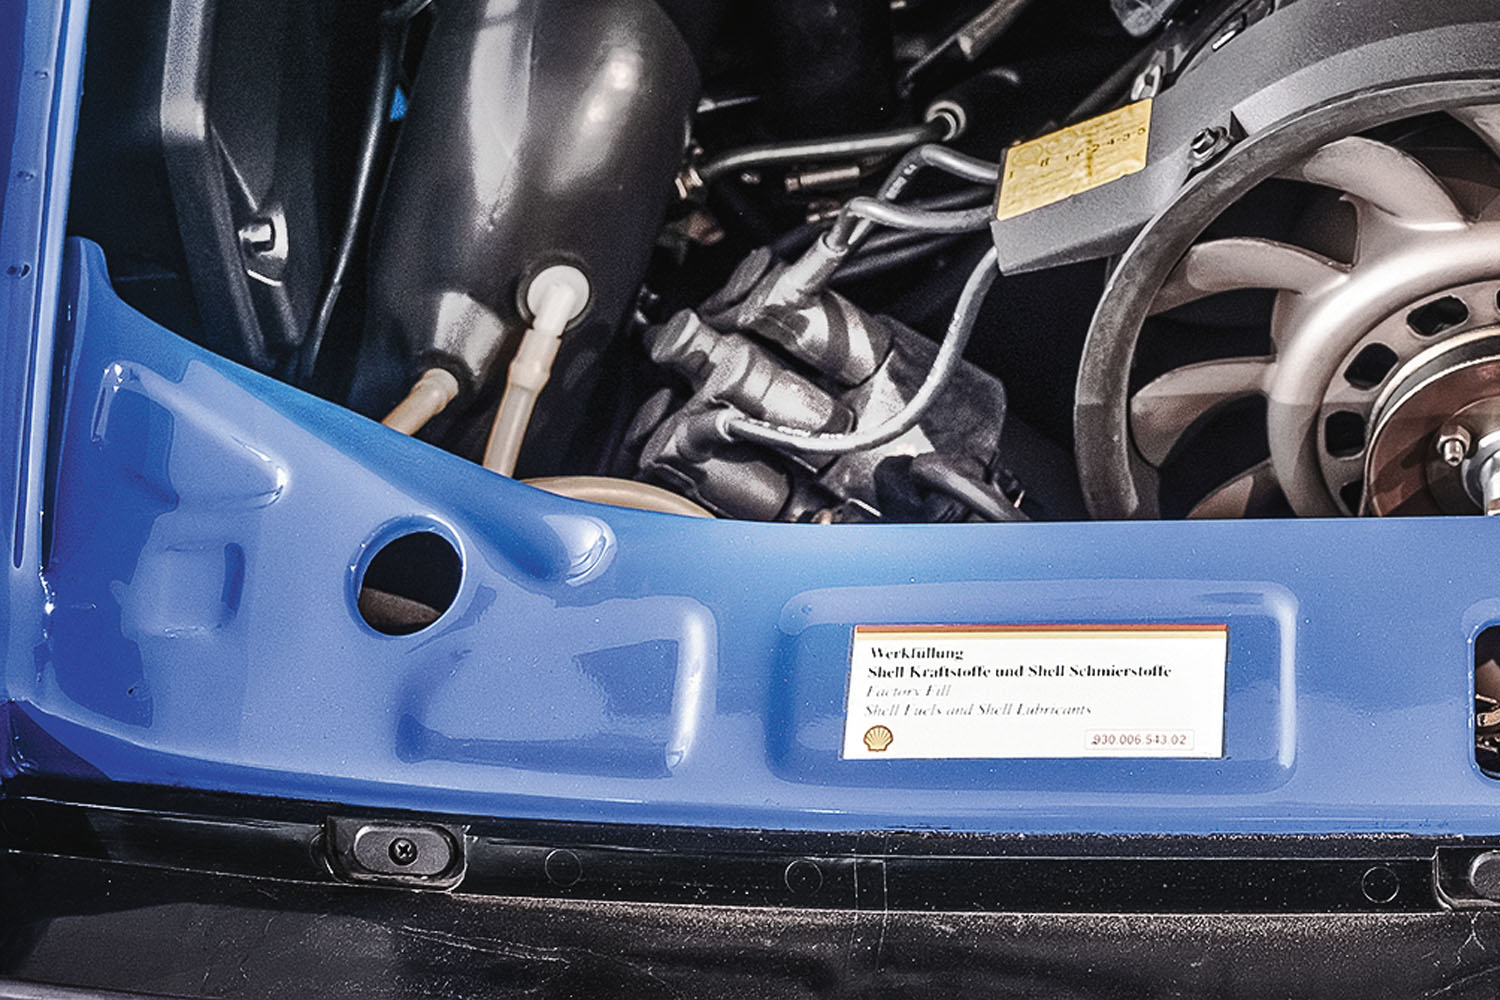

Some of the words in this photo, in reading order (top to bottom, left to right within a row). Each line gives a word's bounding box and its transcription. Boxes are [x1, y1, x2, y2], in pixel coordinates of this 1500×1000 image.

[871, 646, 964, 660] Werkfüllung
[868, 666, 905, 678] Shell
[910, 665, 991, 678] Kraftstoffe
[995, 664, 1024, 678] und
[1028, 664, 1065, 677] Shell
[1069, 663, 1172, 677] Schmierstoffe
[866, 685, 920, 698] Factory
[925, 684, 952, 696] Fill
[865, 703, 900, 716] Shell
[904, 703, 942, 716] Fuels
[946, 703, 974, 716] and
[978, 703, 1013, 716] Shell
[1016, 702, 1092, 716] Lubricants
